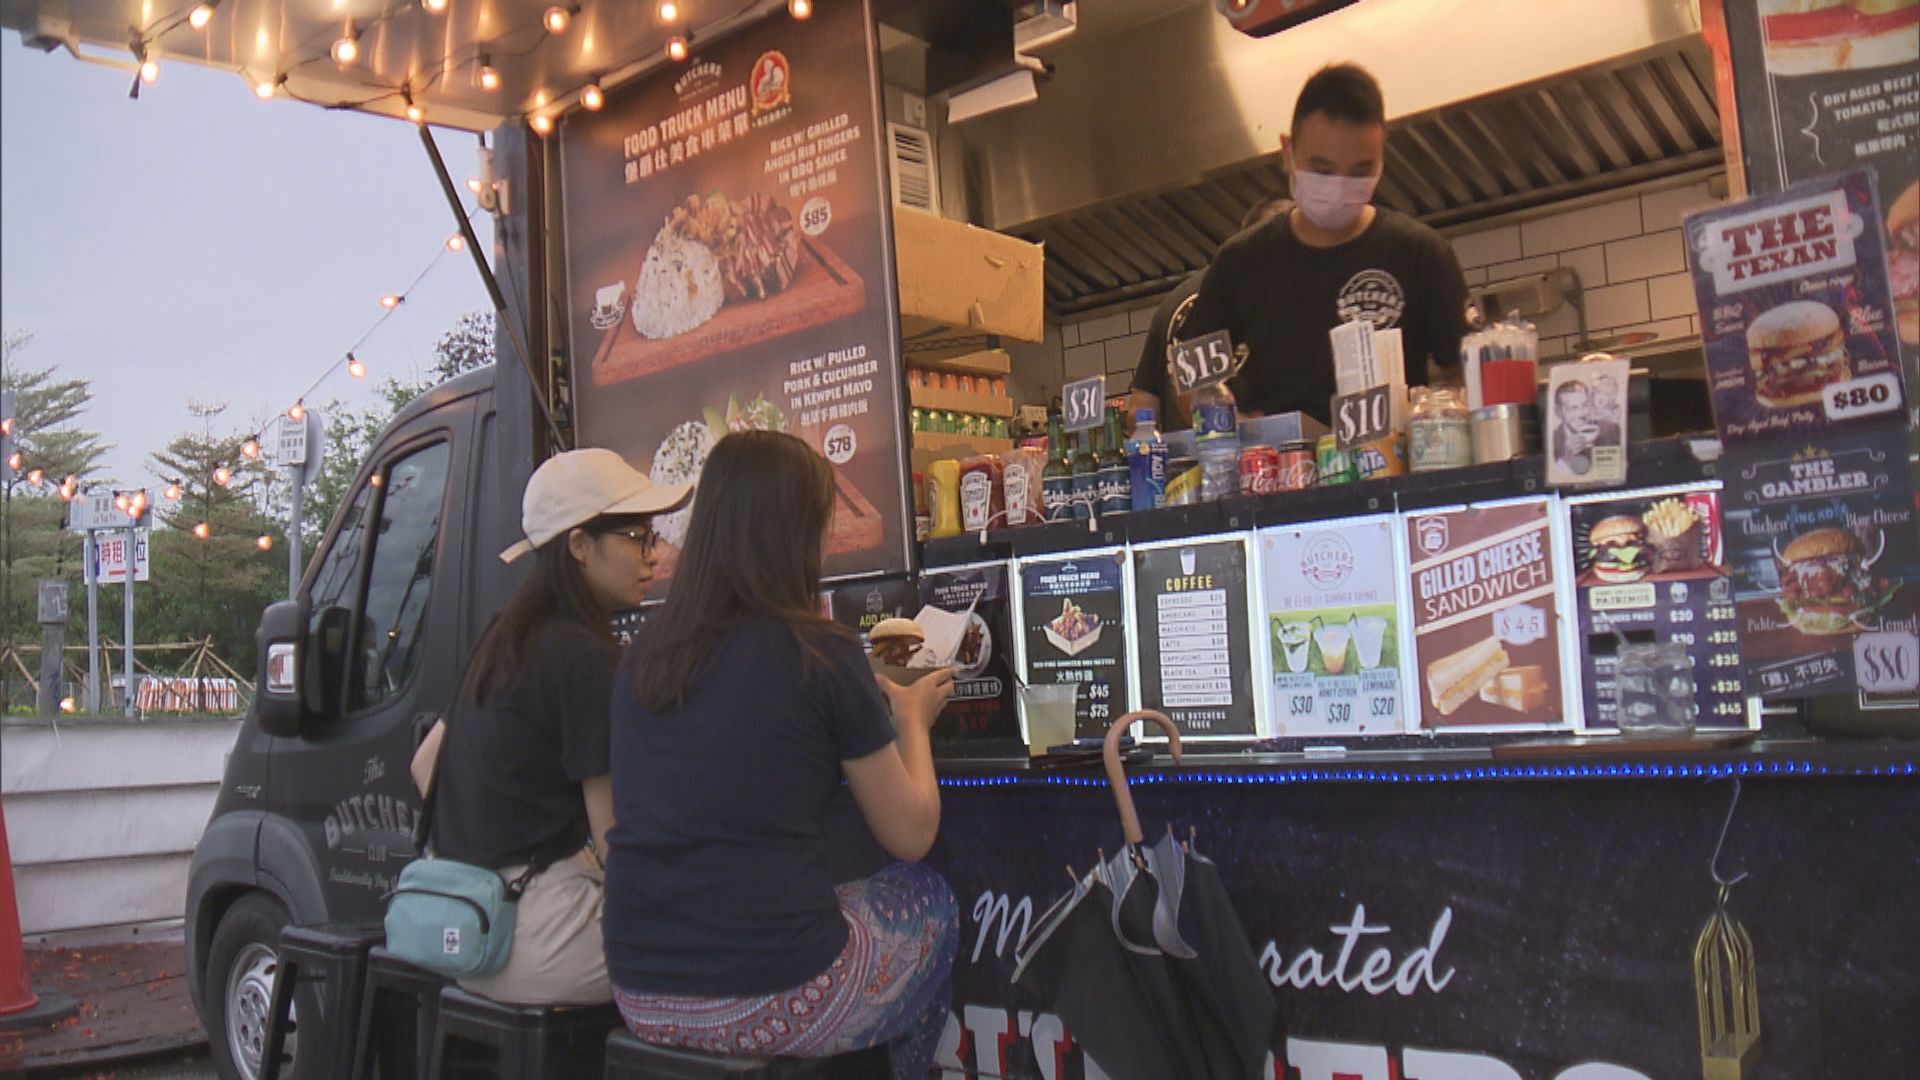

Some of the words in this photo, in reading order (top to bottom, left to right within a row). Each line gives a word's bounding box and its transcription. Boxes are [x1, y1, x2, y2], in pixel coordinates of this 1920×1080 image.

[1823, 93, 1847, 107] DRY
[623, 126, 658, 158] FOOD
[659, 104, 703, 142] TRUCK
[705, 84, 747, 122] MENU
[770, 136, 792, 154] RICE
[793, 129, 806, 144] W/
[807, 113, 848, 139] GRILLED
[764, 151, 796, 174] ANGUS
[817, 126, 860, 153] FINGERS
[779, 170, 790, 184] IN
[791, 159, 813, 180] BBQ
[815, 148, 848, 171] SAUCE
[804, 206, 828, 229] $85
[1722, 205, 1835, 257] THE
[1727, 238, 1838, 281] TEXAN
[790, 359, 812, 376] RICE
[813, 354, 826, 369] W/
[828, 345, 866, 366] PULLED
[1175, 340, 1230, 388] $15
[784, 377, 811, 395] PORK
[812, 373, 821, 387] &
[822, 360, 878, 384] CUCUMBER
[791, 395, 802, 410] IN
[803, 386, 842, 406] KEWPIE
[843, 380, 873, 398] MAYO
[1069, 386, 1098, 425] $30
[1833, 384, 1890, 411] $80
[1338, 394, 1388, 445] $10
[828, 436, 851, 456] $78
[1790, 459, 1835, 480] THE
[1762, 471, 1870, 499] GAMBLER
[1742, 515, 1788, 536] Chicken
[1846, 512, 1871, 528] Blue
[1873, 508, 1910, 525] Cheese
[101, 537, 146, 565] 時租位
[1301, 551, 1355, 569] BUTCHERS
[1419, 555, 1476, 600] GILLED
[1478, 530, 1544, 580] CHEESE
[1165, 575, 1213, 591] COFFEE
[1424, 561, 1548, 622] SANDWICH
[859, 614, 879, 627] ADD
[1705, 607, 1736, 621] +$25
[1747, 616, 1776, 633] Pickle
[1501, 616, 1539, 635] $45
[1162, 640, 1181, 648] LATTE
[1707, 631, 1737, 644] +$25
[1164, 669, 1184, 677] BLACK
[1185, 668, 1197, 676] TEA
[1864, 643, 1910, 686] $80
[1089, 683, 1109, 699] $45
[1711, 678, 1742, 692] +$35
[1089, 703, 1109, 718] $75
[1172, 712, 1185, 721] THE
[1188, 710, 1226, 720] BUTCHERS
[1291, 695, 1312, 716] $30
[1328, 703, 1350, 723] $30
[1372, 697, 1394, 716] $20
[1712, 703, 1742, 716] +$45
[363, 756, 384, 785] The
[368, 844, 387, 862] CLUB
